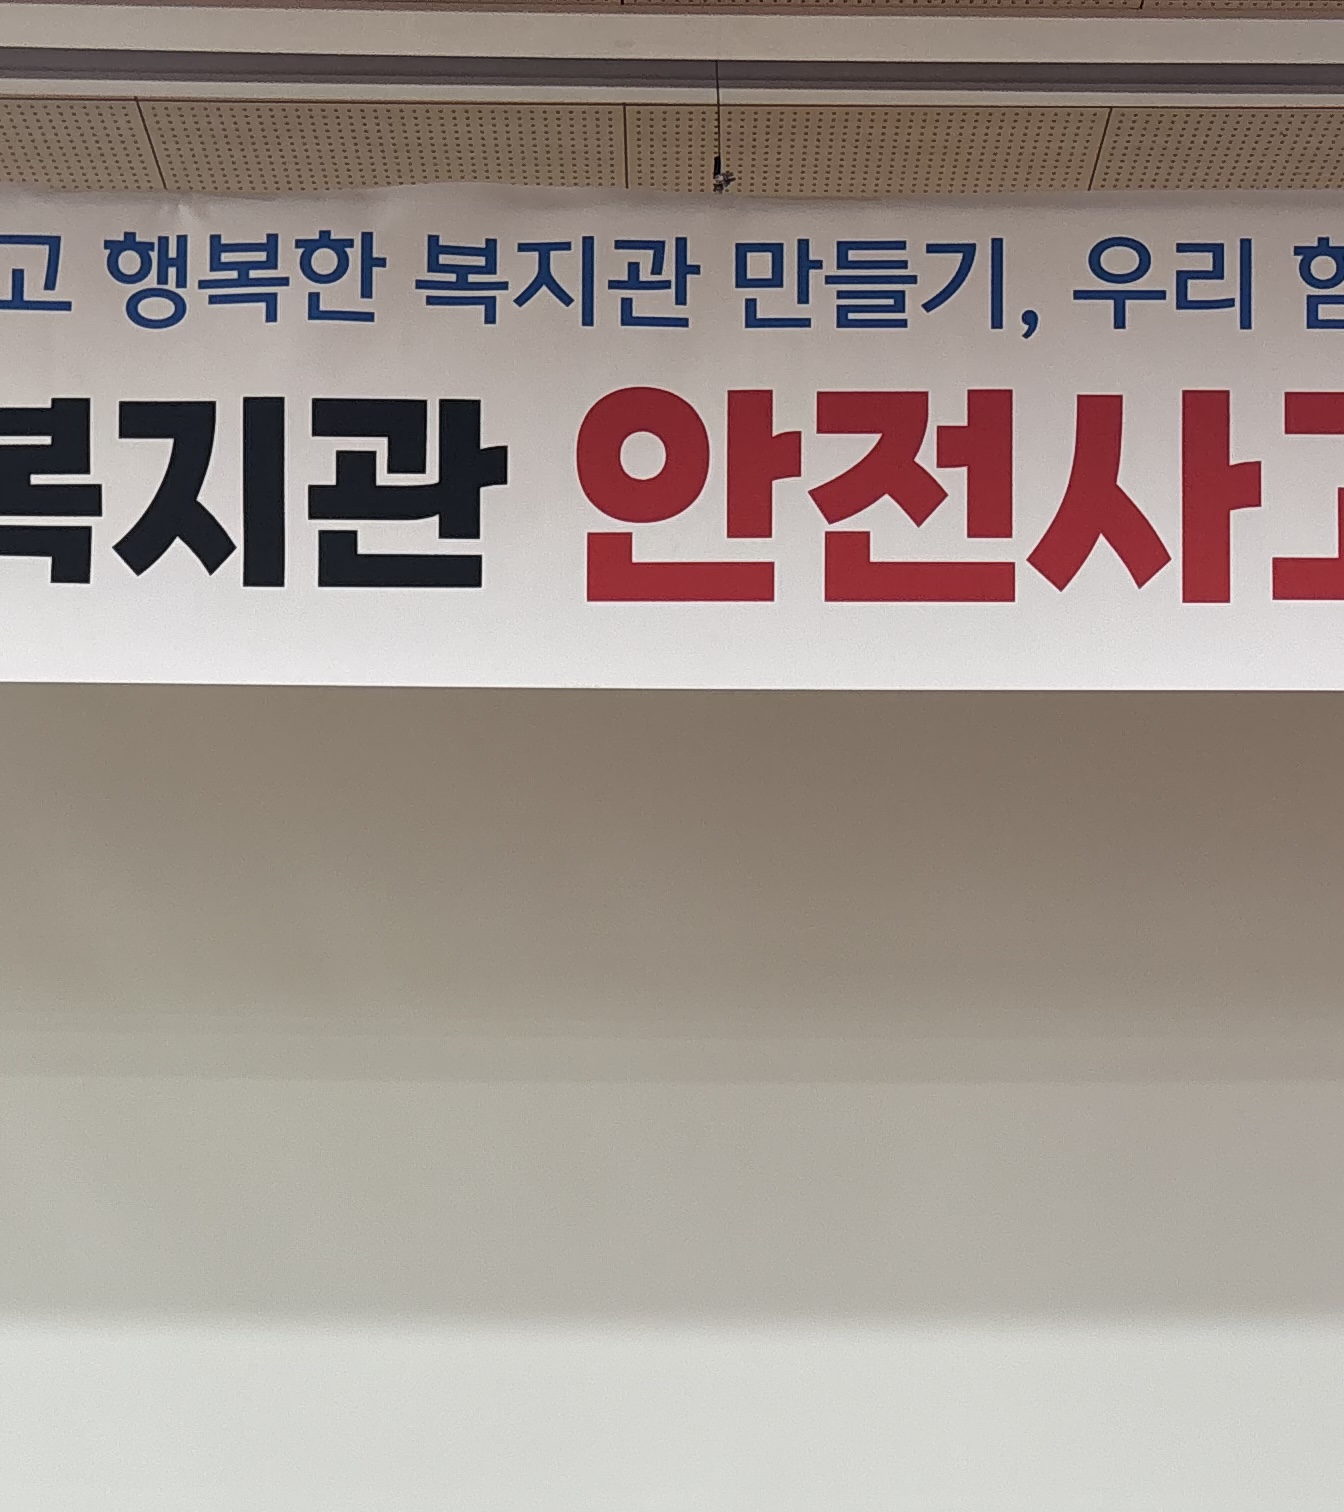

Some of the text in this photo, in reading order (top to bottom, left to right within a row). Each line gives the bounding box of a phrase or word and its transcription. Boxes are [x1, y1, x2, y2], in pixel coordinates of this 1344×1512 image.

[103, 230, 387, 329] 행복한
[414, 234, 701, 328] 복지관
[734, 237, 1038, 339] 만들기,
[1072, 237, 1252, 329] 우리
